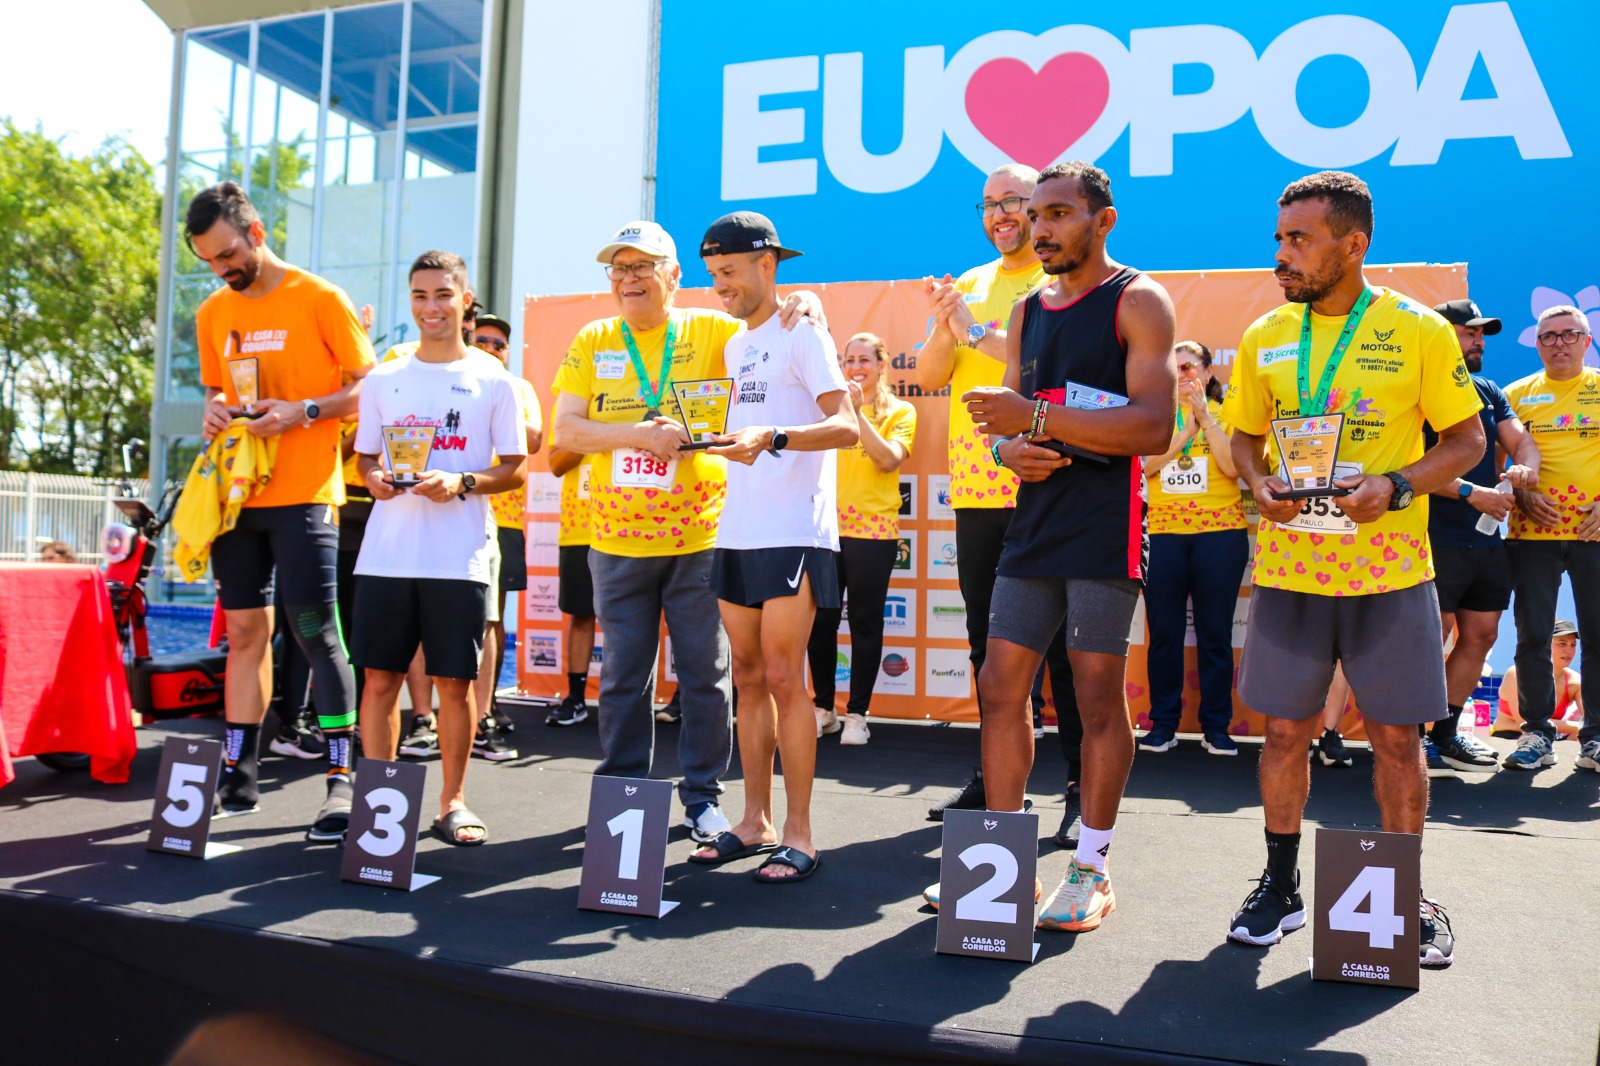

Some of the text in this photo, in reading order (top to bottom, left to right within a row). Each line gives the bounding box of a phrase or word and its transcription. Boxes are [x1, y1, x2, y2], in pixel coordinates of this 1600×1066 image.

[1129, 1, 1573, 178] POA
[720, 45, 945, 201] EU
[1361, 344, 1402, 353] MOTOR'S
[757, 381, 768, 392] DO
[1281, 409, 1300, 417] Corri
[1347, 418, 1385, 427] Inclusão
[432, 436, 467, 450] RUN
[623, 456, 668, 476] 3138
[1168, 473, 1201, 485] 6510
[161, 762, 208, 828] 5
[357, 787, 409, 857] 3
[606, 808, 645, 880] 1
[360, 873, 392, 882] CORREDOR
[955, 843, 1019, 924] 2
[600, 898, 638, 907] CORREDOR
[1328, 865, 1405, 949] 4
[971, 937, 991, 945] CASA
[962, 943, 1006, 953] CORREDOR
[1342, 962, 1389, 973] A CASA DO
[1342, 970, 1389, 980] CORREDOR
